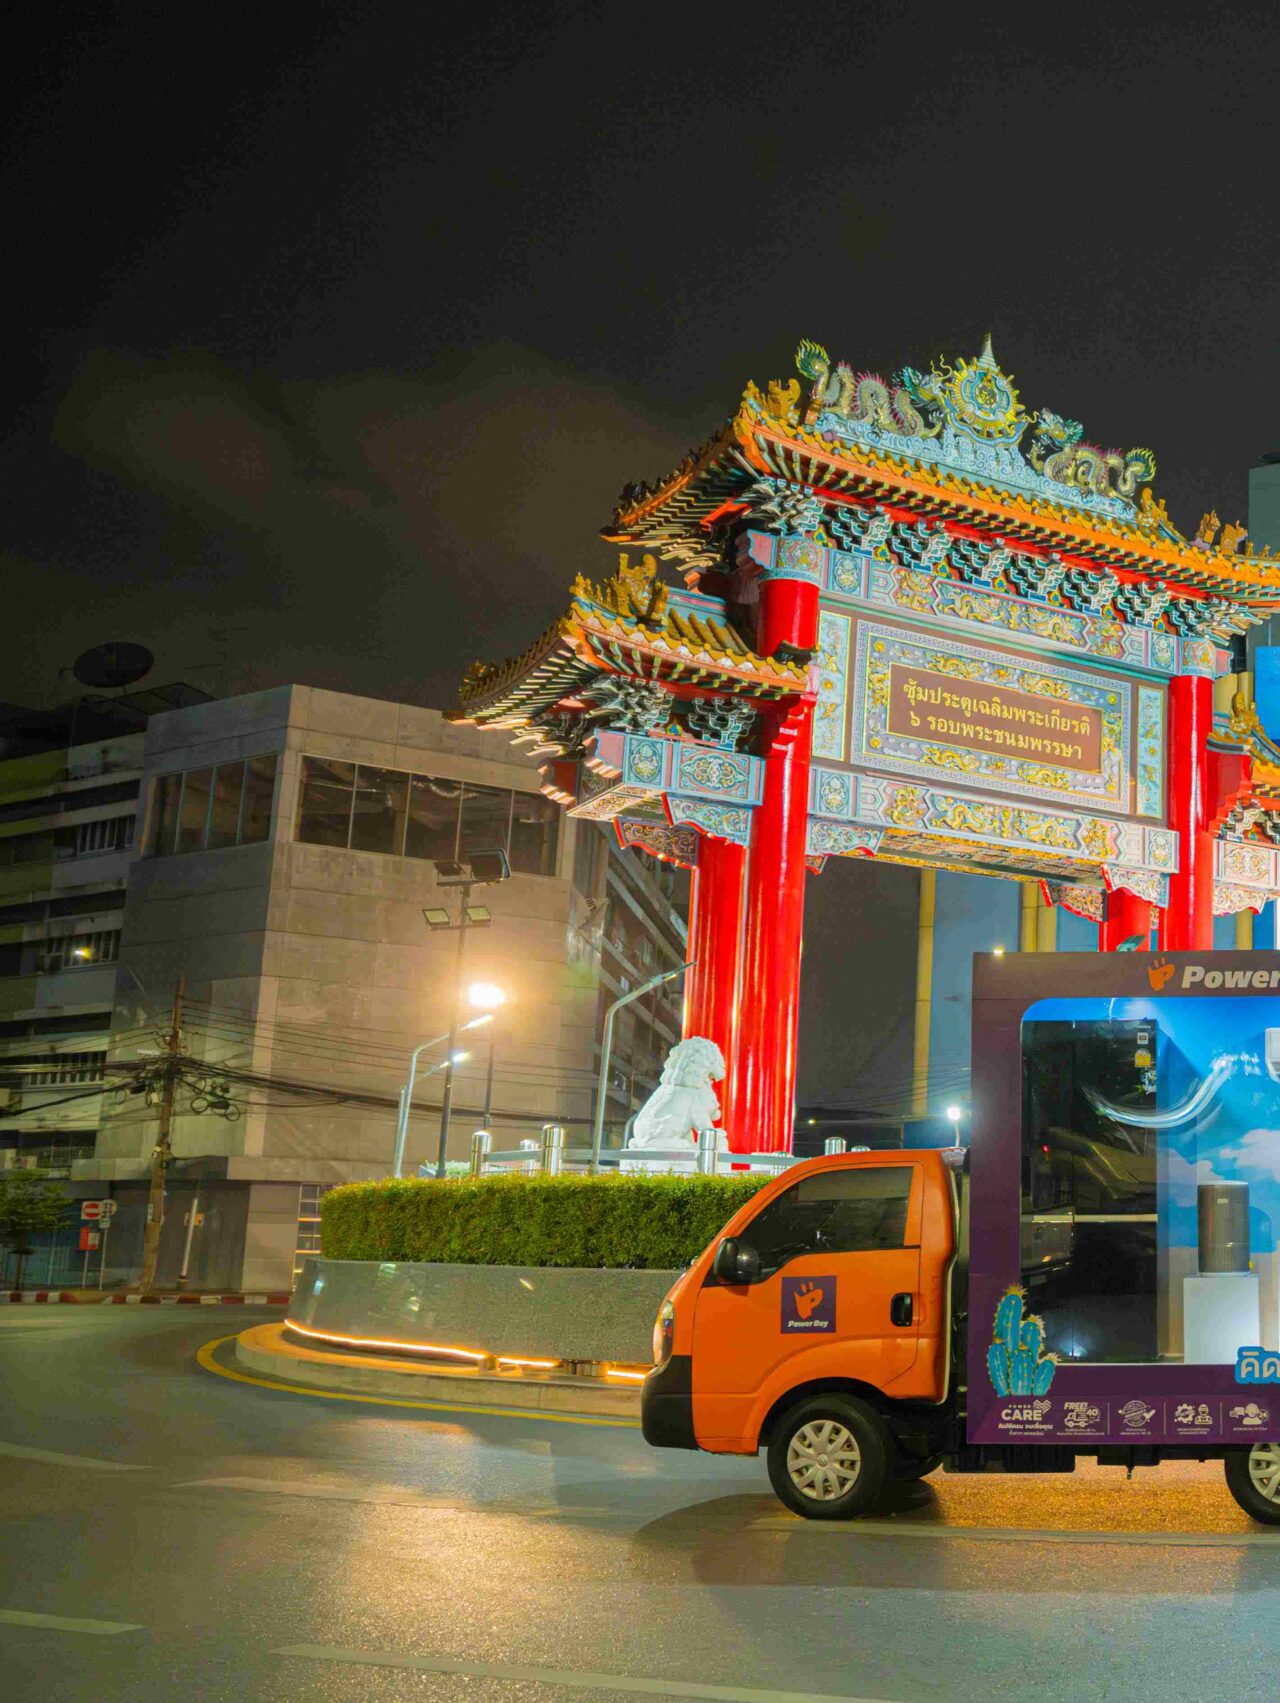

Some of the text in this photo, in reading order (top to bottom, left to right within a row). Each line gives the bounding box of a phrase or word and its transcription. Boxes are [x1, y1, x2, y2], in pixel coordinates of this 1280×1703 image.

[903, 678, 1090, 736] ซุ้มประตูเฉลิมพระเกียรติ
[927, 715, 1082, 760] รอบพระชนมพรรษา
[788, 1320, 829, 1328] Power Buy
[1001, 1409, 1043, 1421] CARE
